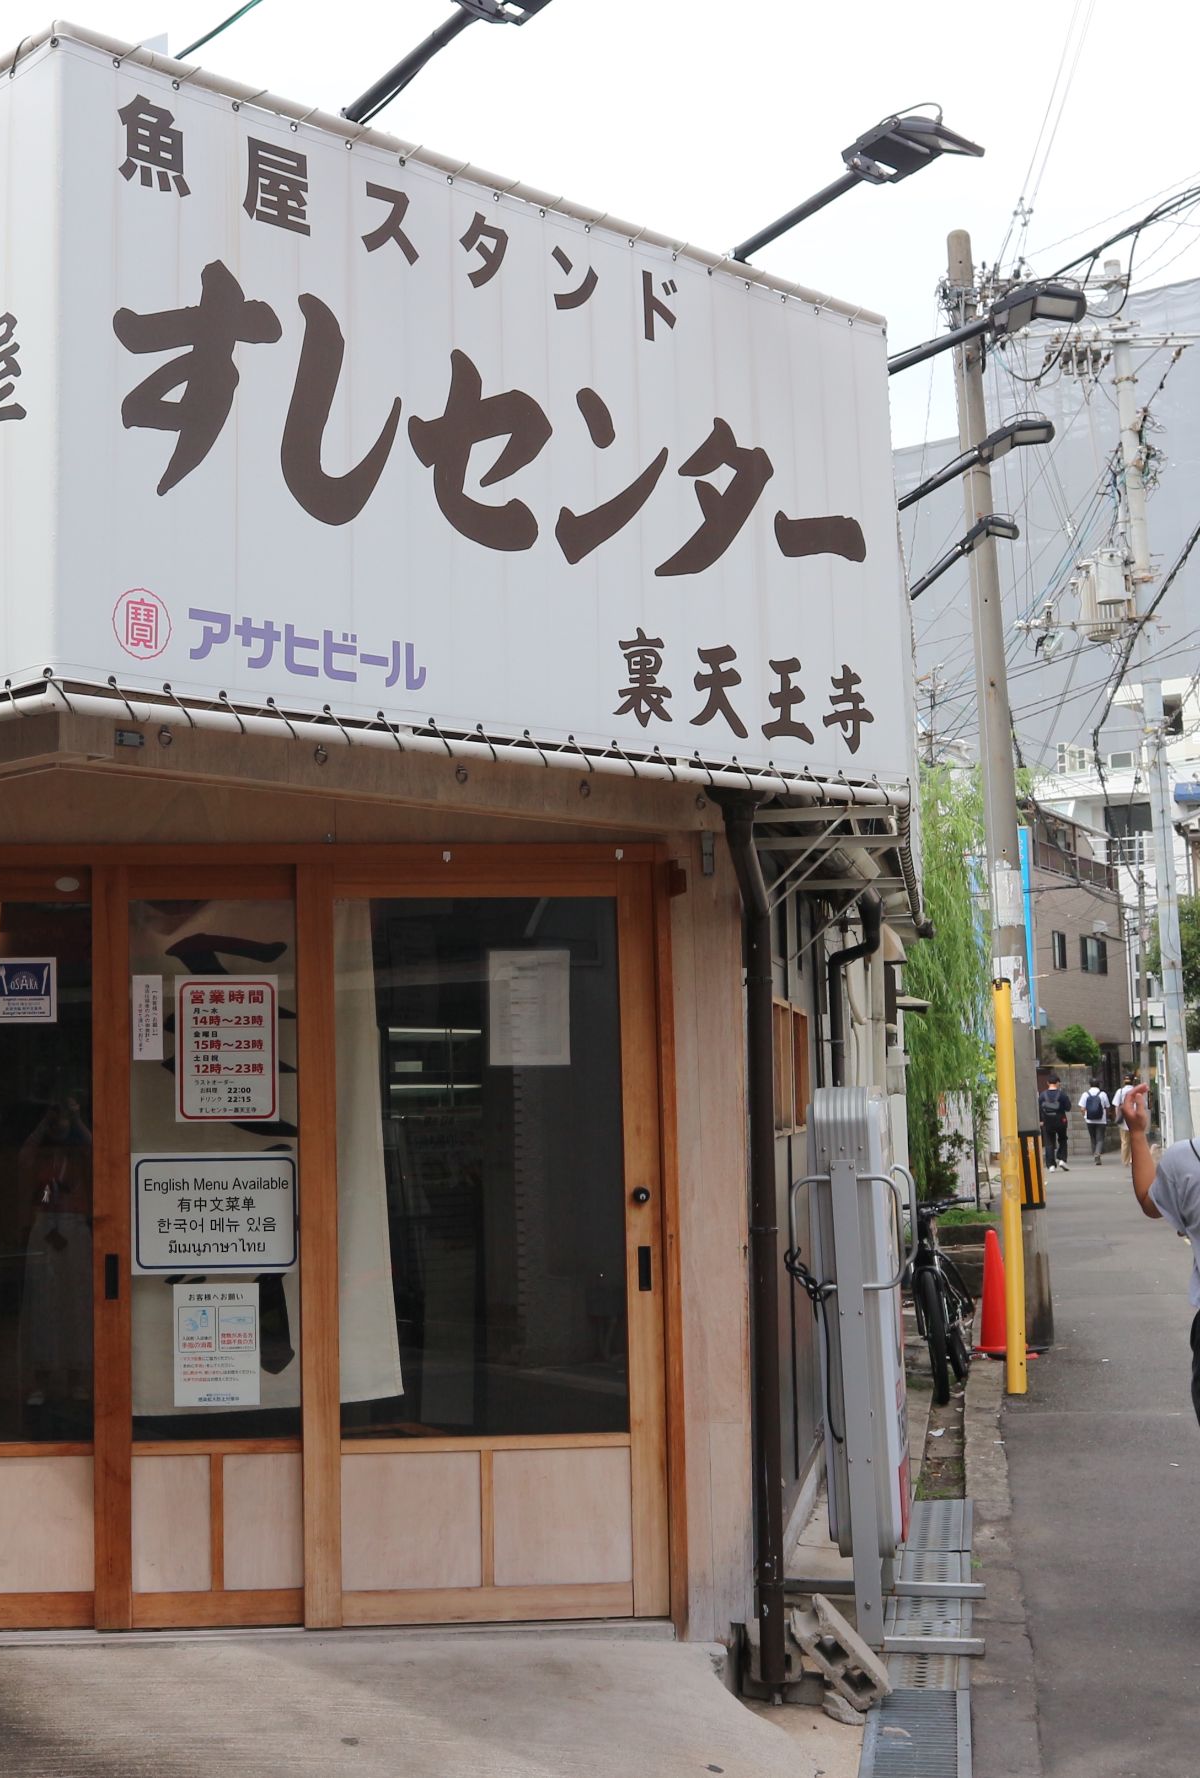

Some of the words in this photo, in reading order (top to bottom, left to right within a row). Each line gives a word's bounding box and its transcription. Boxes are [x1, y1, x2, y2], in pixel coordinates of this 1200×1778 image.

[117, 95, 677, 342] 魚屋スタンド
[113, 260, 867, 577] すしセンター
[188, 608, 427, 691] アサヒビール
[612, 627, 875, 755] 裏天王寺
[190, 990, 264, 1005] 営業時間
[144, 1178, 190, 1194] English
[193, 1178, 228, 1191] Menu
[232, 1176, 289, 1191] Available
[177, 1196, 256, 1213] 有中文菜单
[157, 1217, 204, 1234] 한국어
[210, 1217, 241, 1233] 메뉴
[247, 1217, 277, 1232] 있음
[188, 1293, 244, 1302] お客様へお願い
